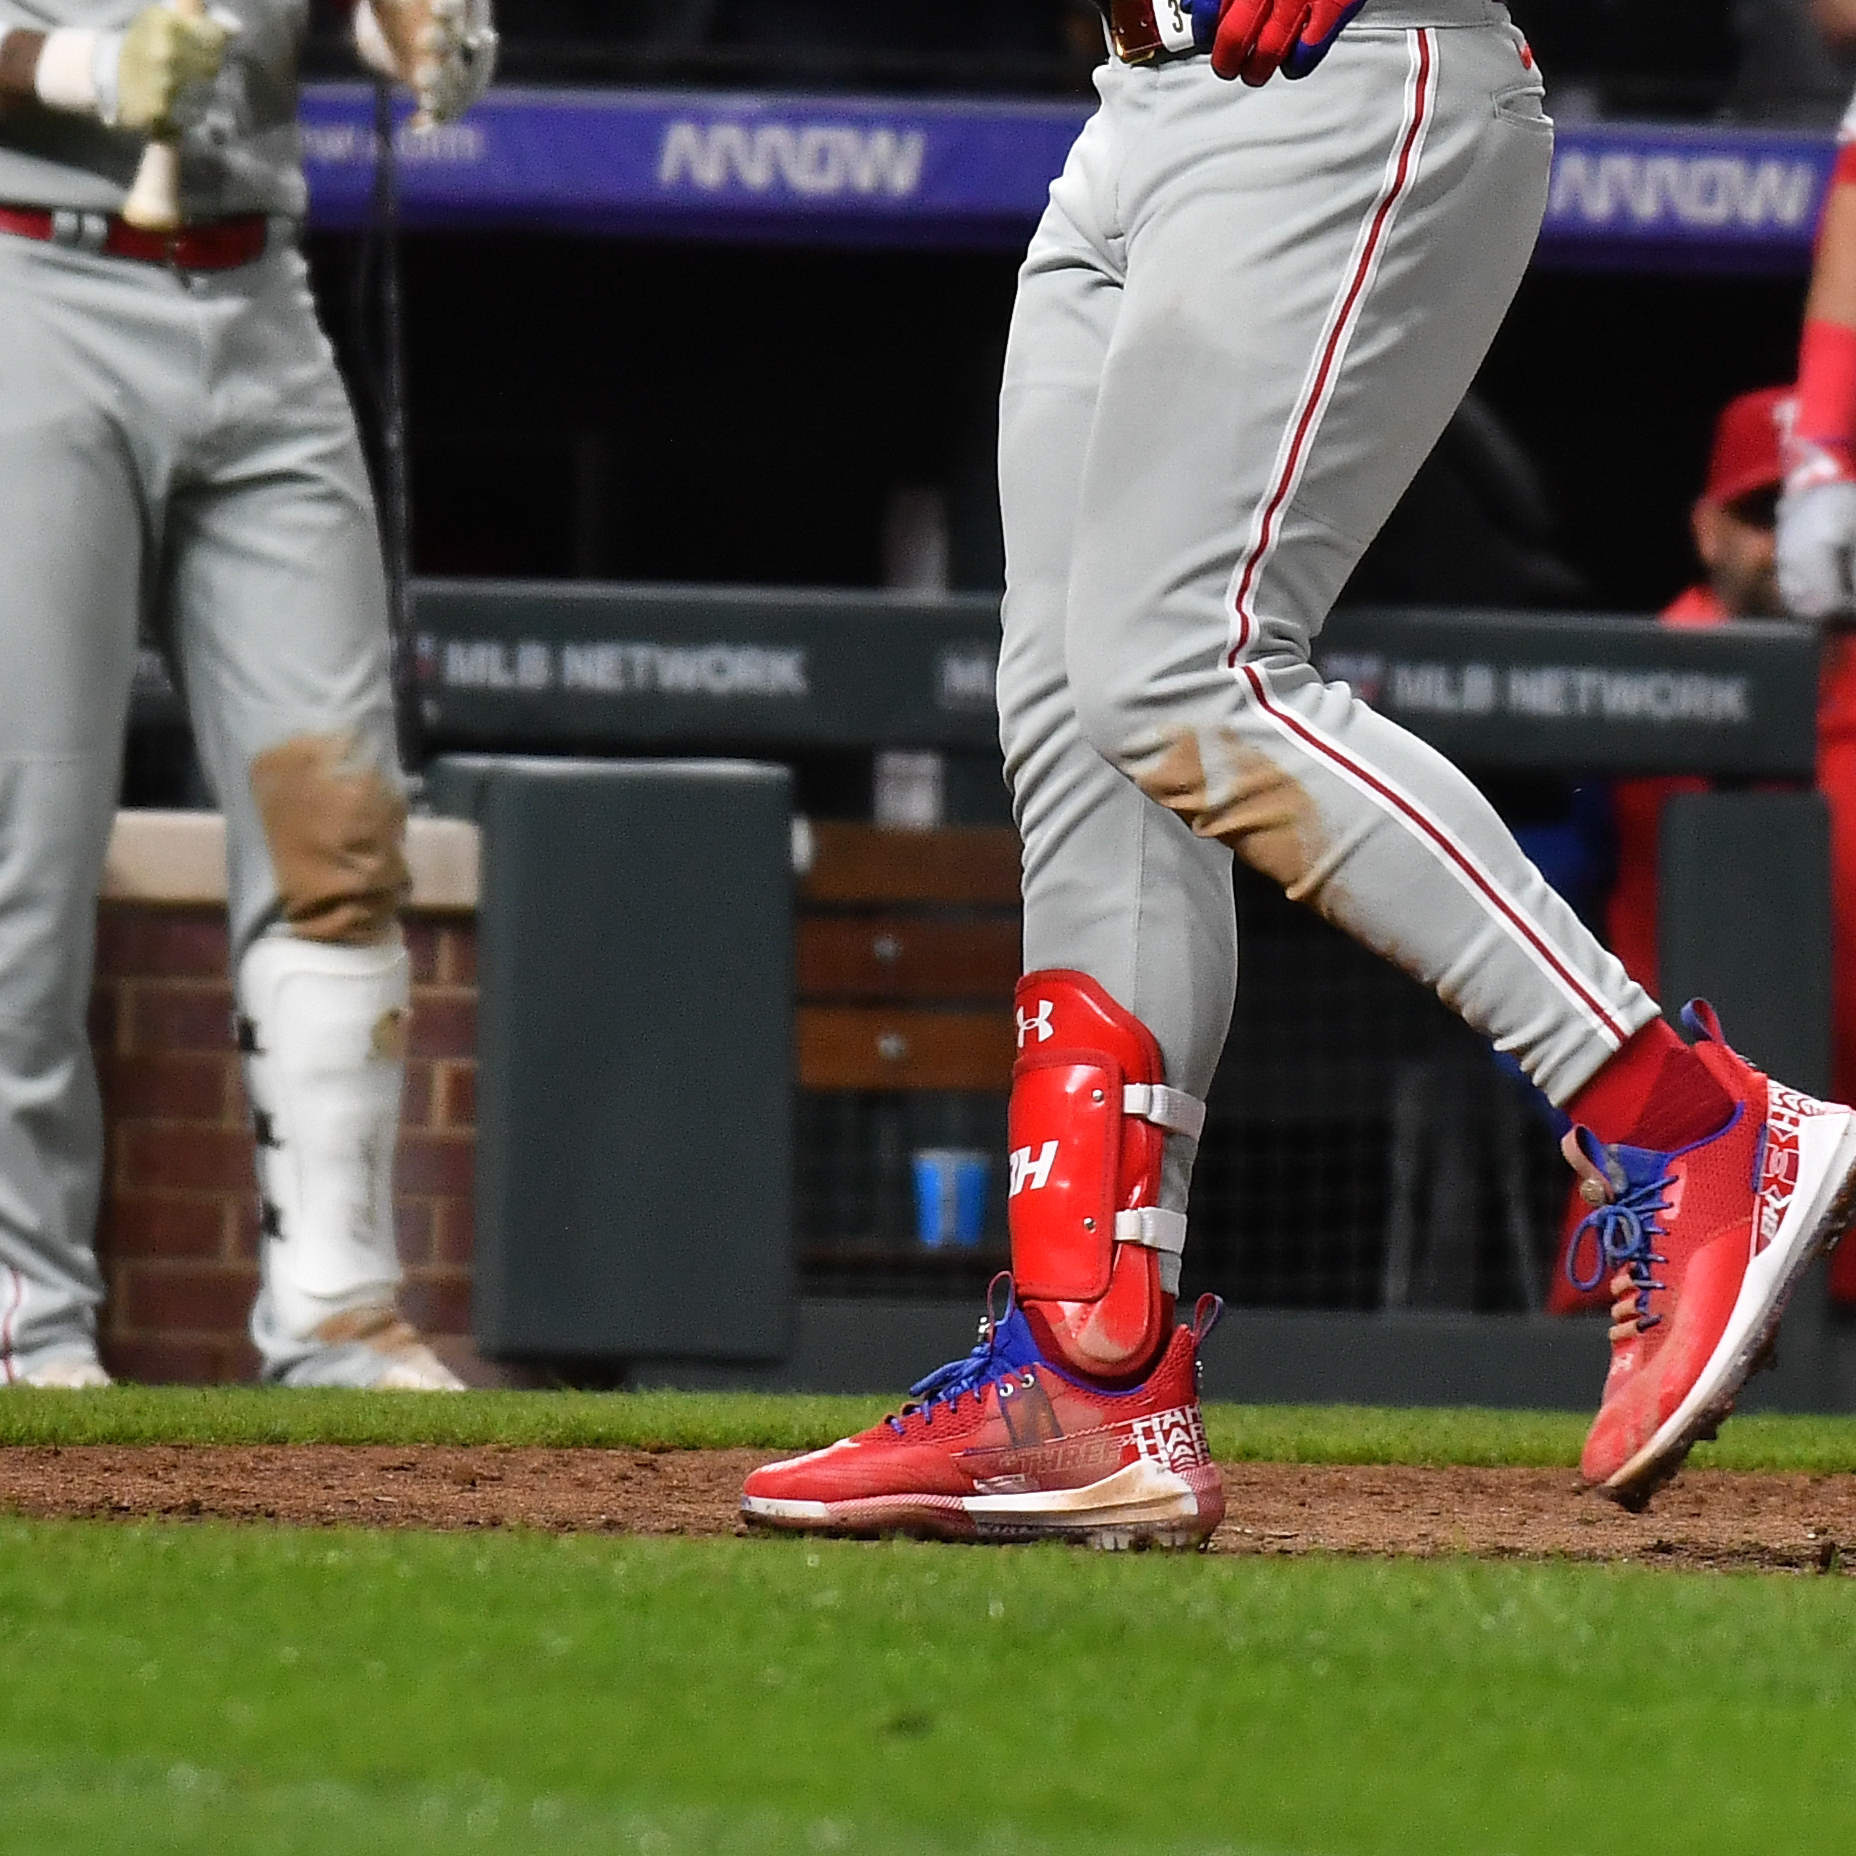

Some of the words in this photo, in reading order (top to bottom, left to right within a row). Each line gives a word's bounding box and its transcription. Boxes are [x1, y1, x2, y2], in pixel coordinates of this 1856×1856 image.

[446, 639, 545, 690] MLB
[562, 643, 806, 698] NETWORK
[1508, 666, 1748, 722] NETWORK
